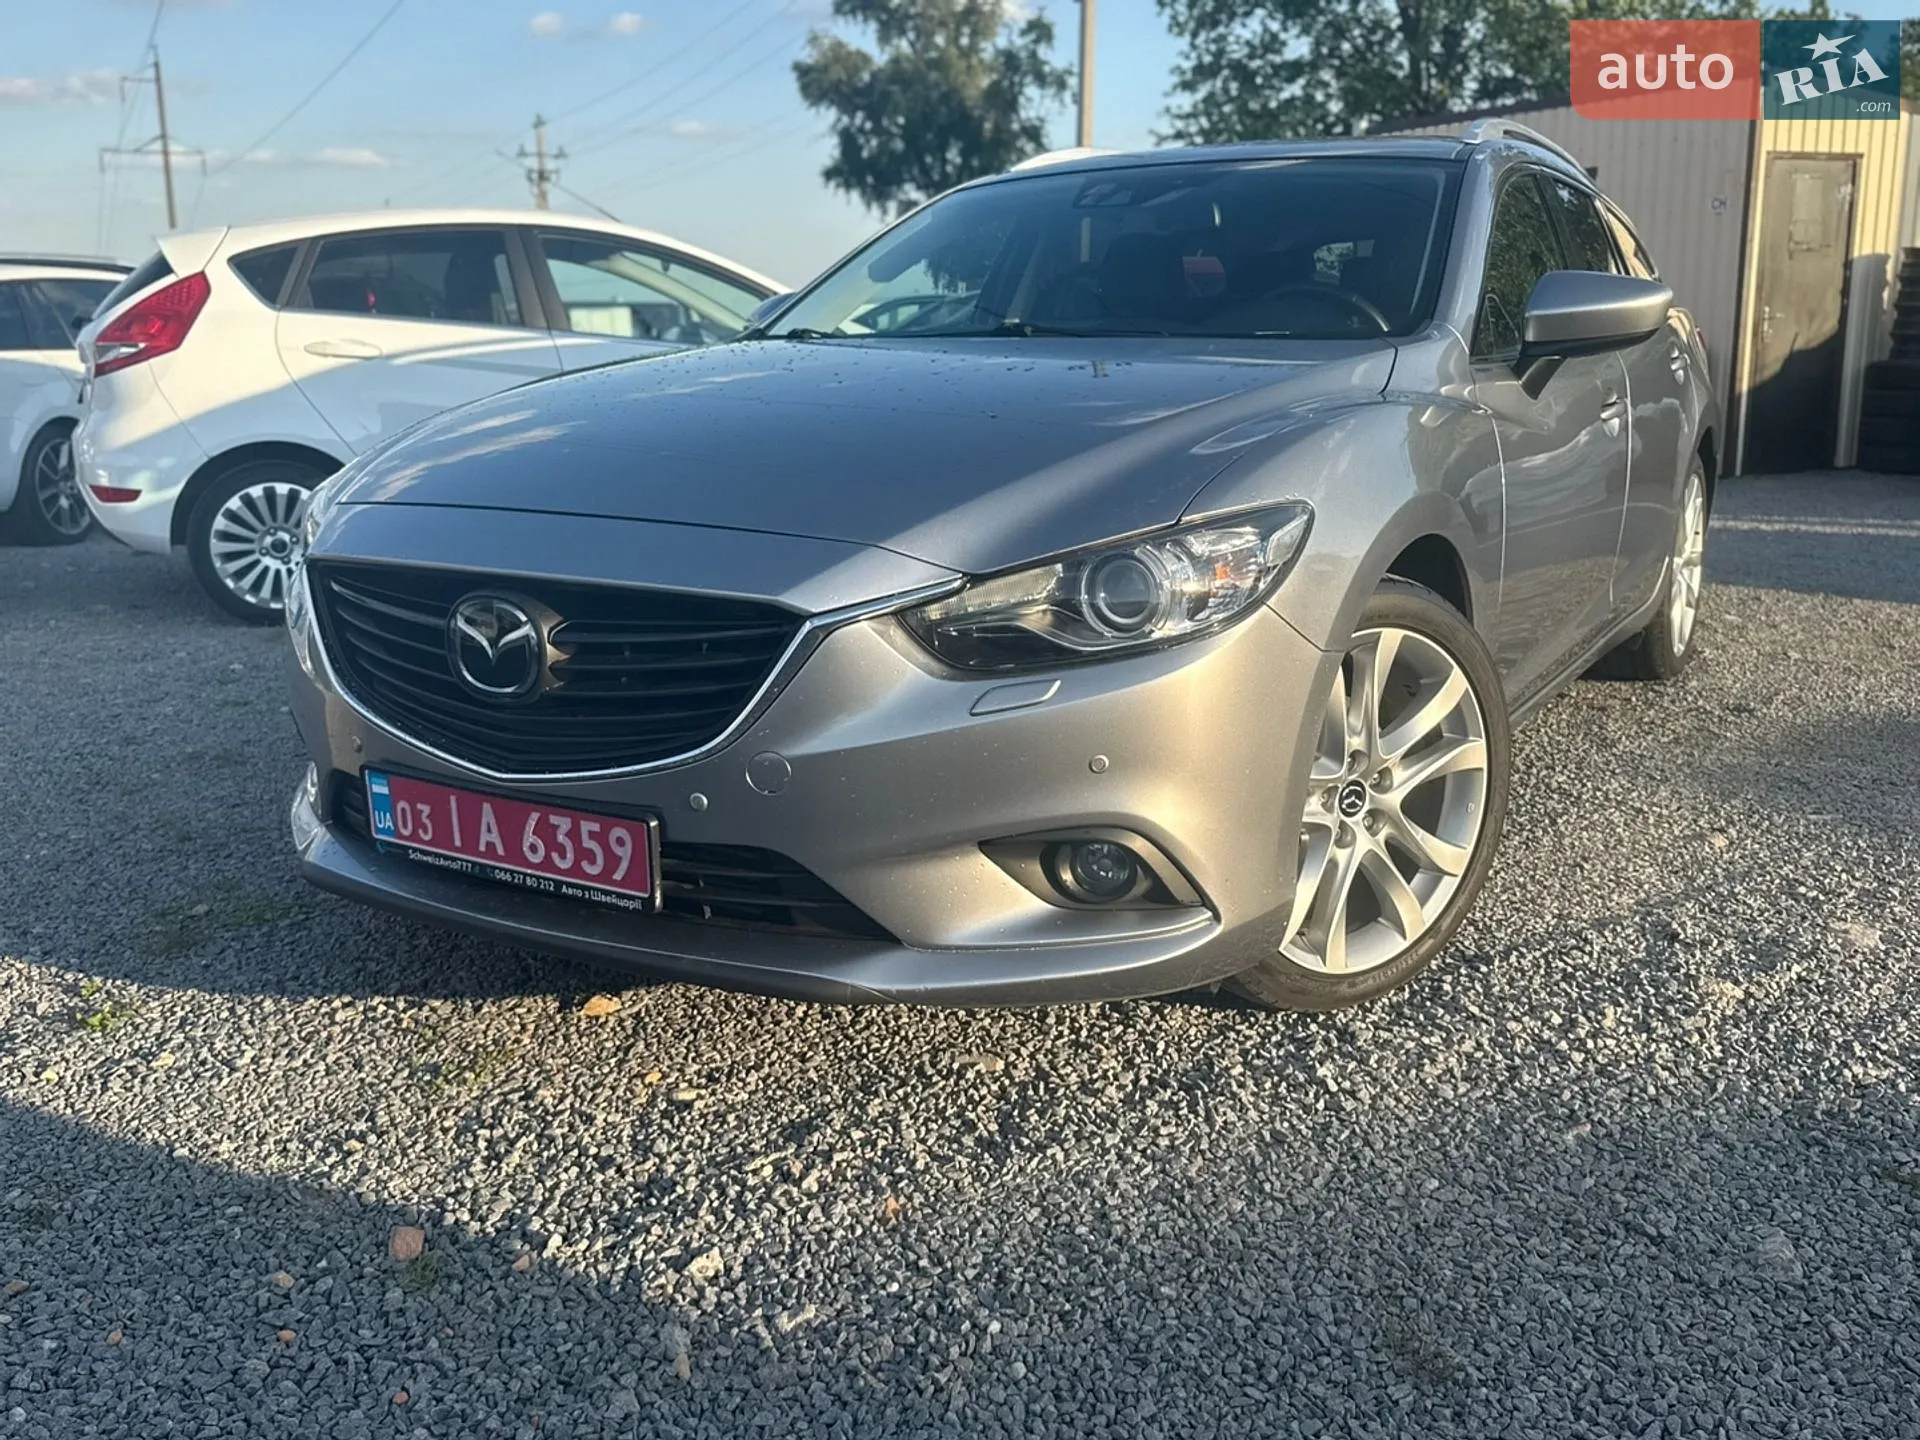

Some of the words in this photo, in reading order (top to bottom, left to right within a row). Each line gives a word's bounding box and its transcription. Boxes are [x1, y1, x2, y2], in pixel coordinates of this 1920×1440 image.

[374, 810, 395, 831] UA
[396, 799, 433, 842] 03
[449, 794, 505, 857] IA
[523, 812, 633, 881] 6359
[494, 869, 512, 882] 066
[513, 872, 524, 884] 27
[539, 878, 555, 892] 212
[561, 884, 583, 898] Авто
